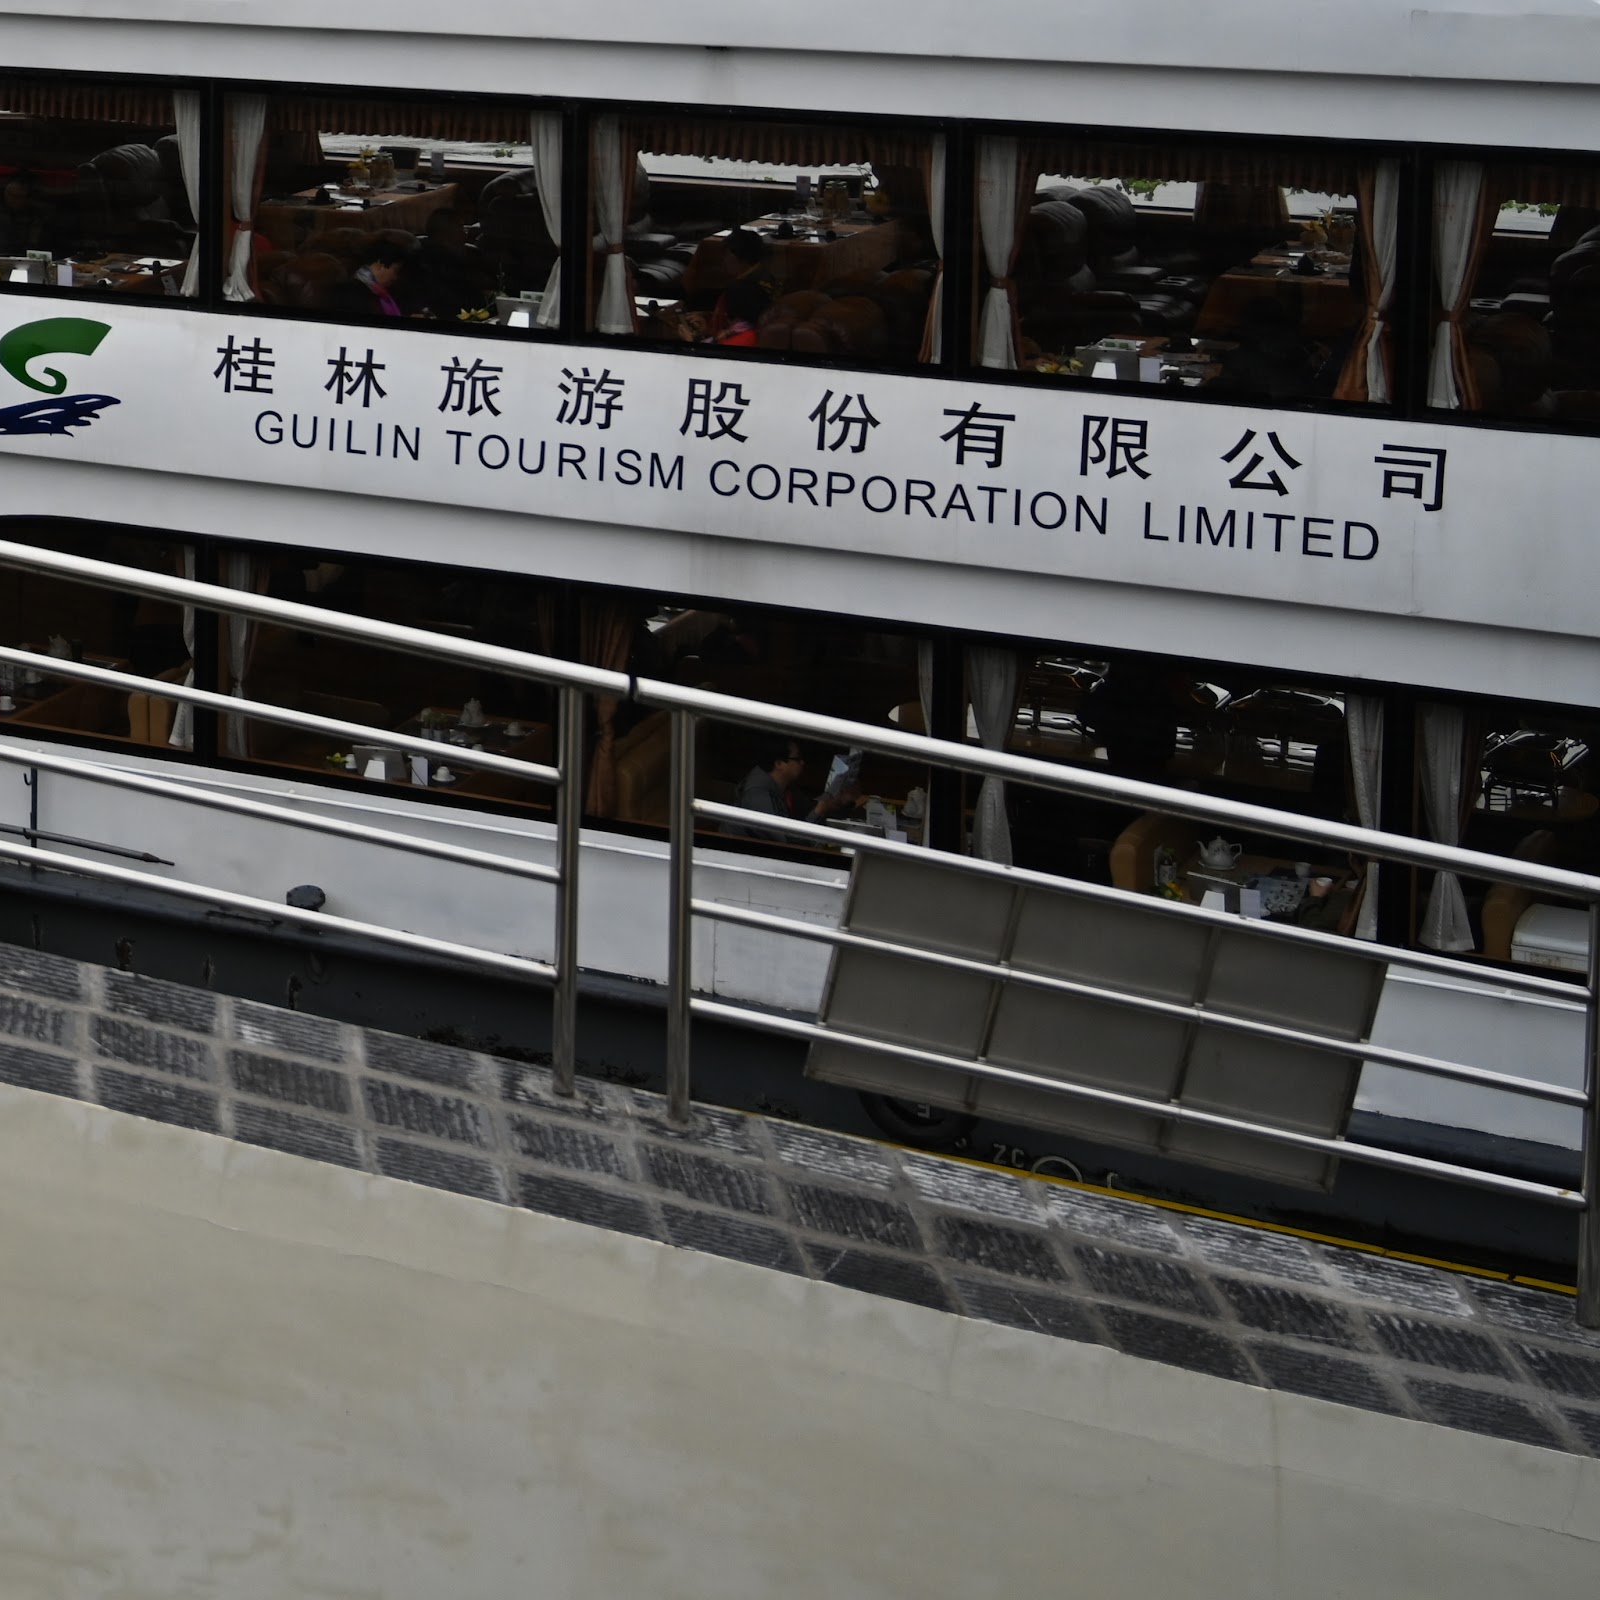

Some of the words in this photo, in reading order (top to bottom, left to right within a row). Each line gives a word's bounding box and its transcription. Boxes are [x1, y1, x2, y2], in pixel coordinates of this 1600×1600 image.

[213, 334, 1449, 513] 桂林旅游股份有限公司
[255, 410, 421, 461] GUILIN
[445, 430, 685, 492] TOURISM
[708, 458, 1109, 536] CORPORATION
[1142, 500, 1382, 562] LIMITED
